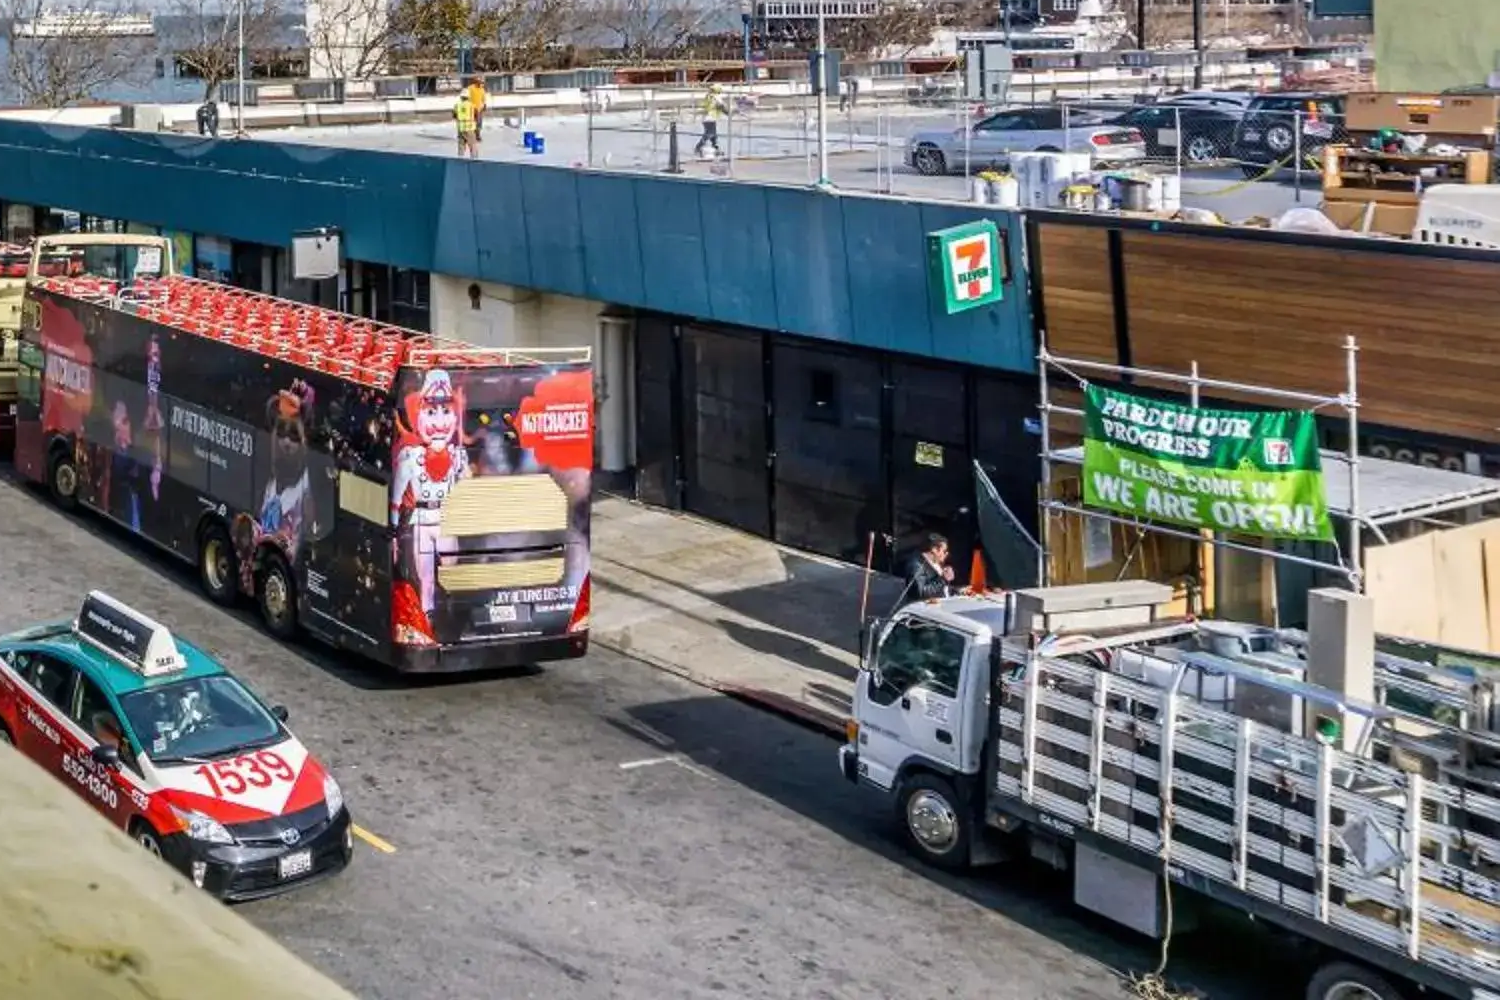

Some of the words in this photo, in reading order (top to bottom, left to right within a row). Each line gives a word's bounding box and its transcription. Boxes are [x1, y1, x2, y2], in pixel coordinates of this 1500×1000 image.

[957, 267, 988, 284] ELEVEN
[215, 422, 231, 449] DEC
[521, 411, 589, 433] NUTCRACKER
[1101, 397, 1194, 433] PARDON
[1199, 416, 1252, 439] OUR
[1101, 419, 1210, 459] PROGRESS
[1119, 457, 1180, 490] PLEASE
[1185, 475, 1248, 497] COME
[1252, 482, 1276, 499] IN
[1093, 470, 1136, 509] WE
[1145, 487, 1203, 523] ARE
[1211, 502, 1317, 535] OPEN!
[77, 747, 97, 772] Cab
[193, 751, 295, 799] 1539
[62, 753, 117, 809] 552-1300
